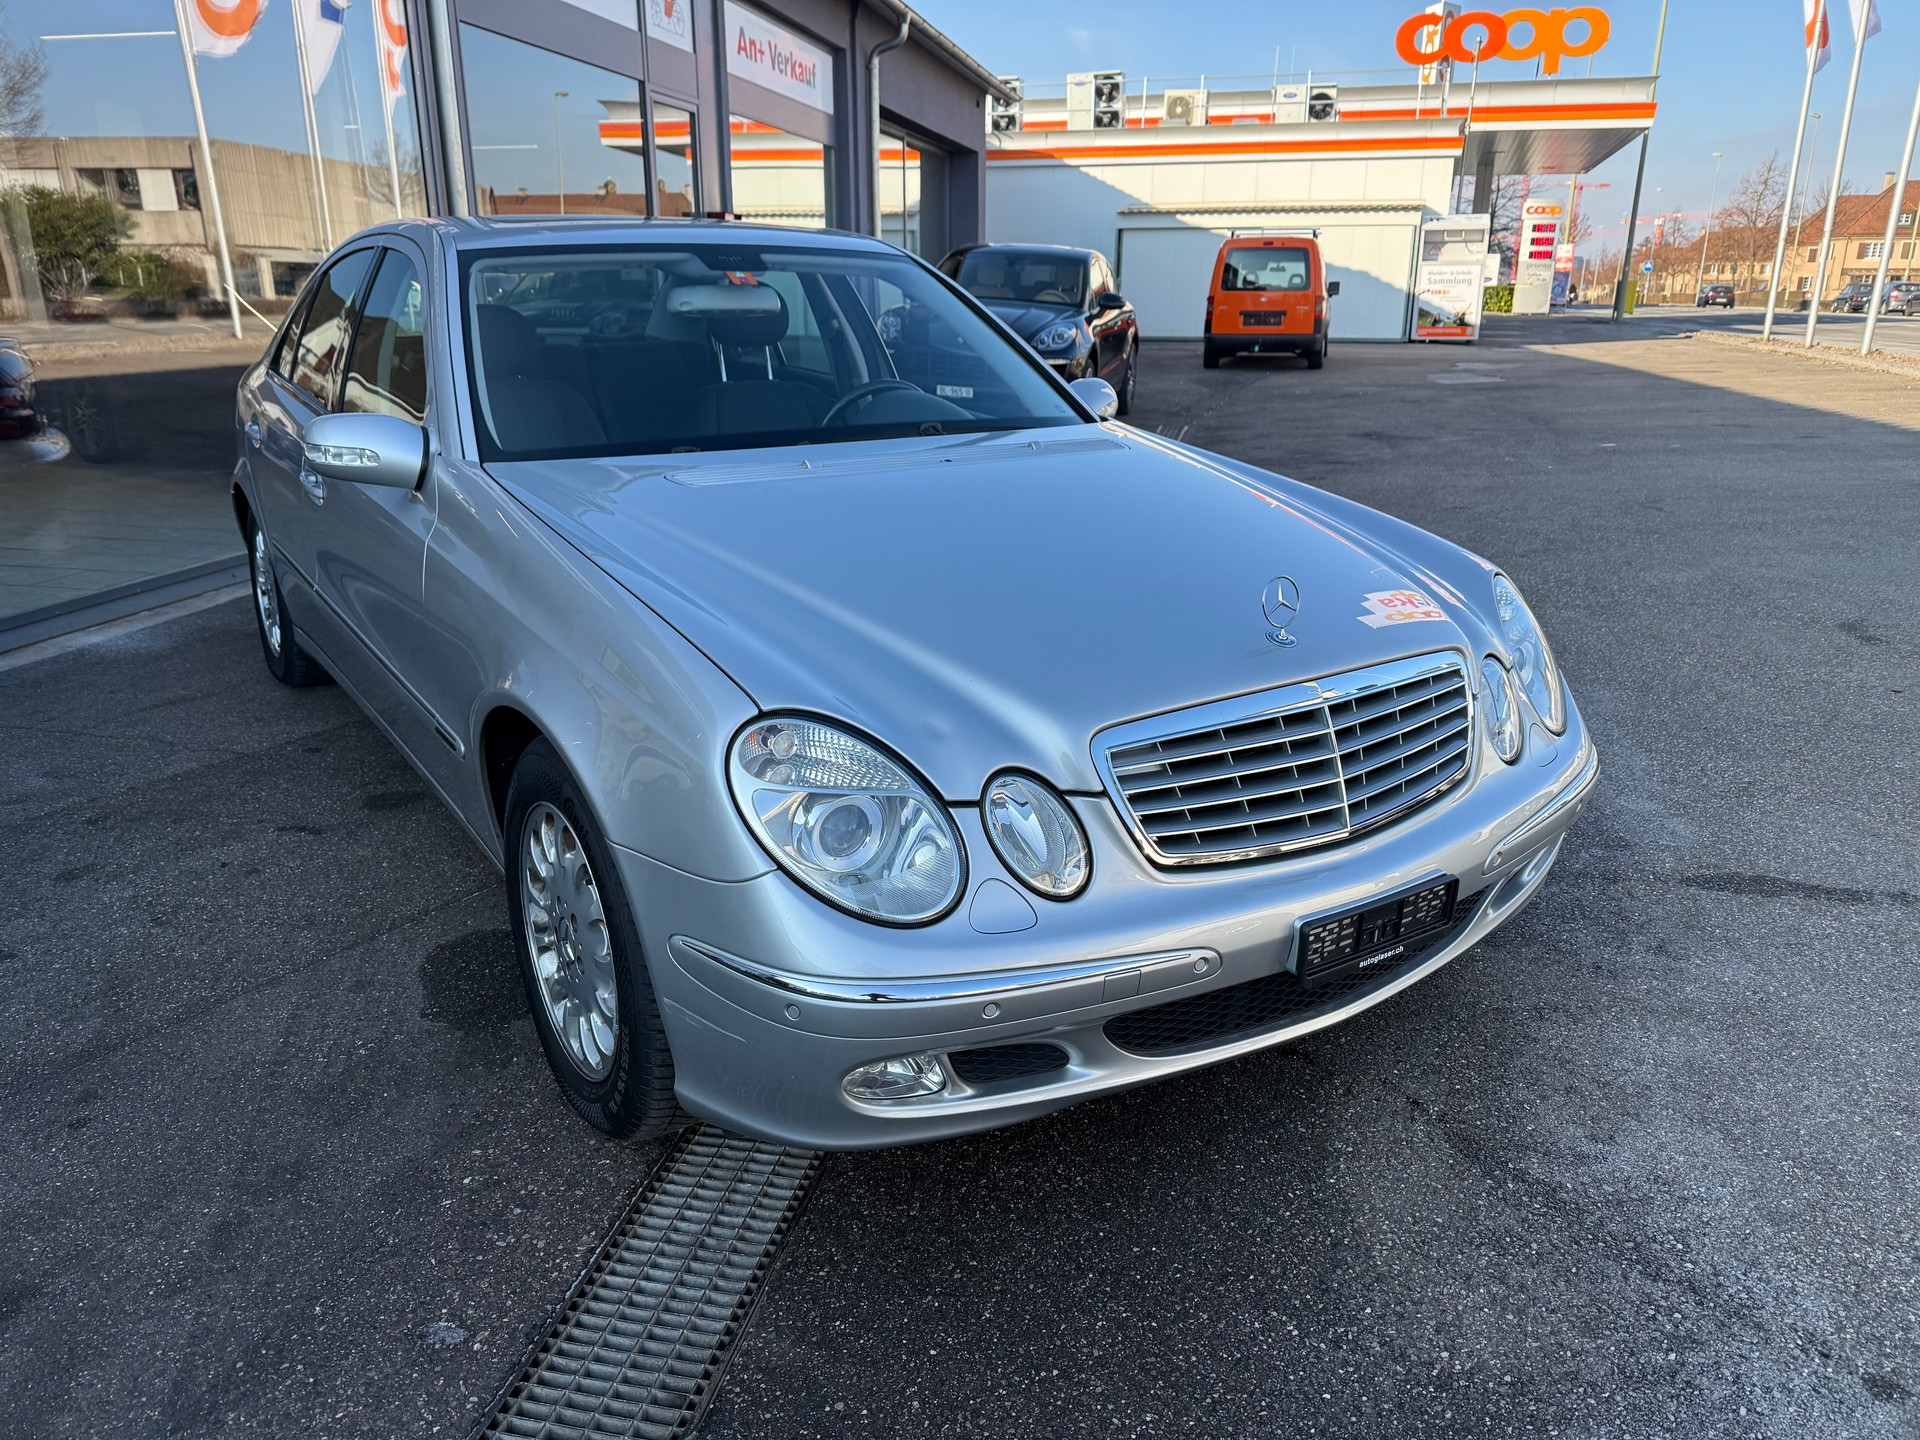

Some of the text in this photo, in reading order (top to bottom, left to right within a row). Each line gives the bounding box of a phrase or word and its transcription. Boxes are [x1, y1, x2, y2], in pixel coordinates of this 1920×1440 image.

[1395, 6, 1611, 74] coop
[767, 40, 816, 89] Verkauf
[1526, 205, 1563, 217] coop
[1427, 276, 1473, 287] Sammlung
[1358, 945, 1404, 968] autoglaser.ch
